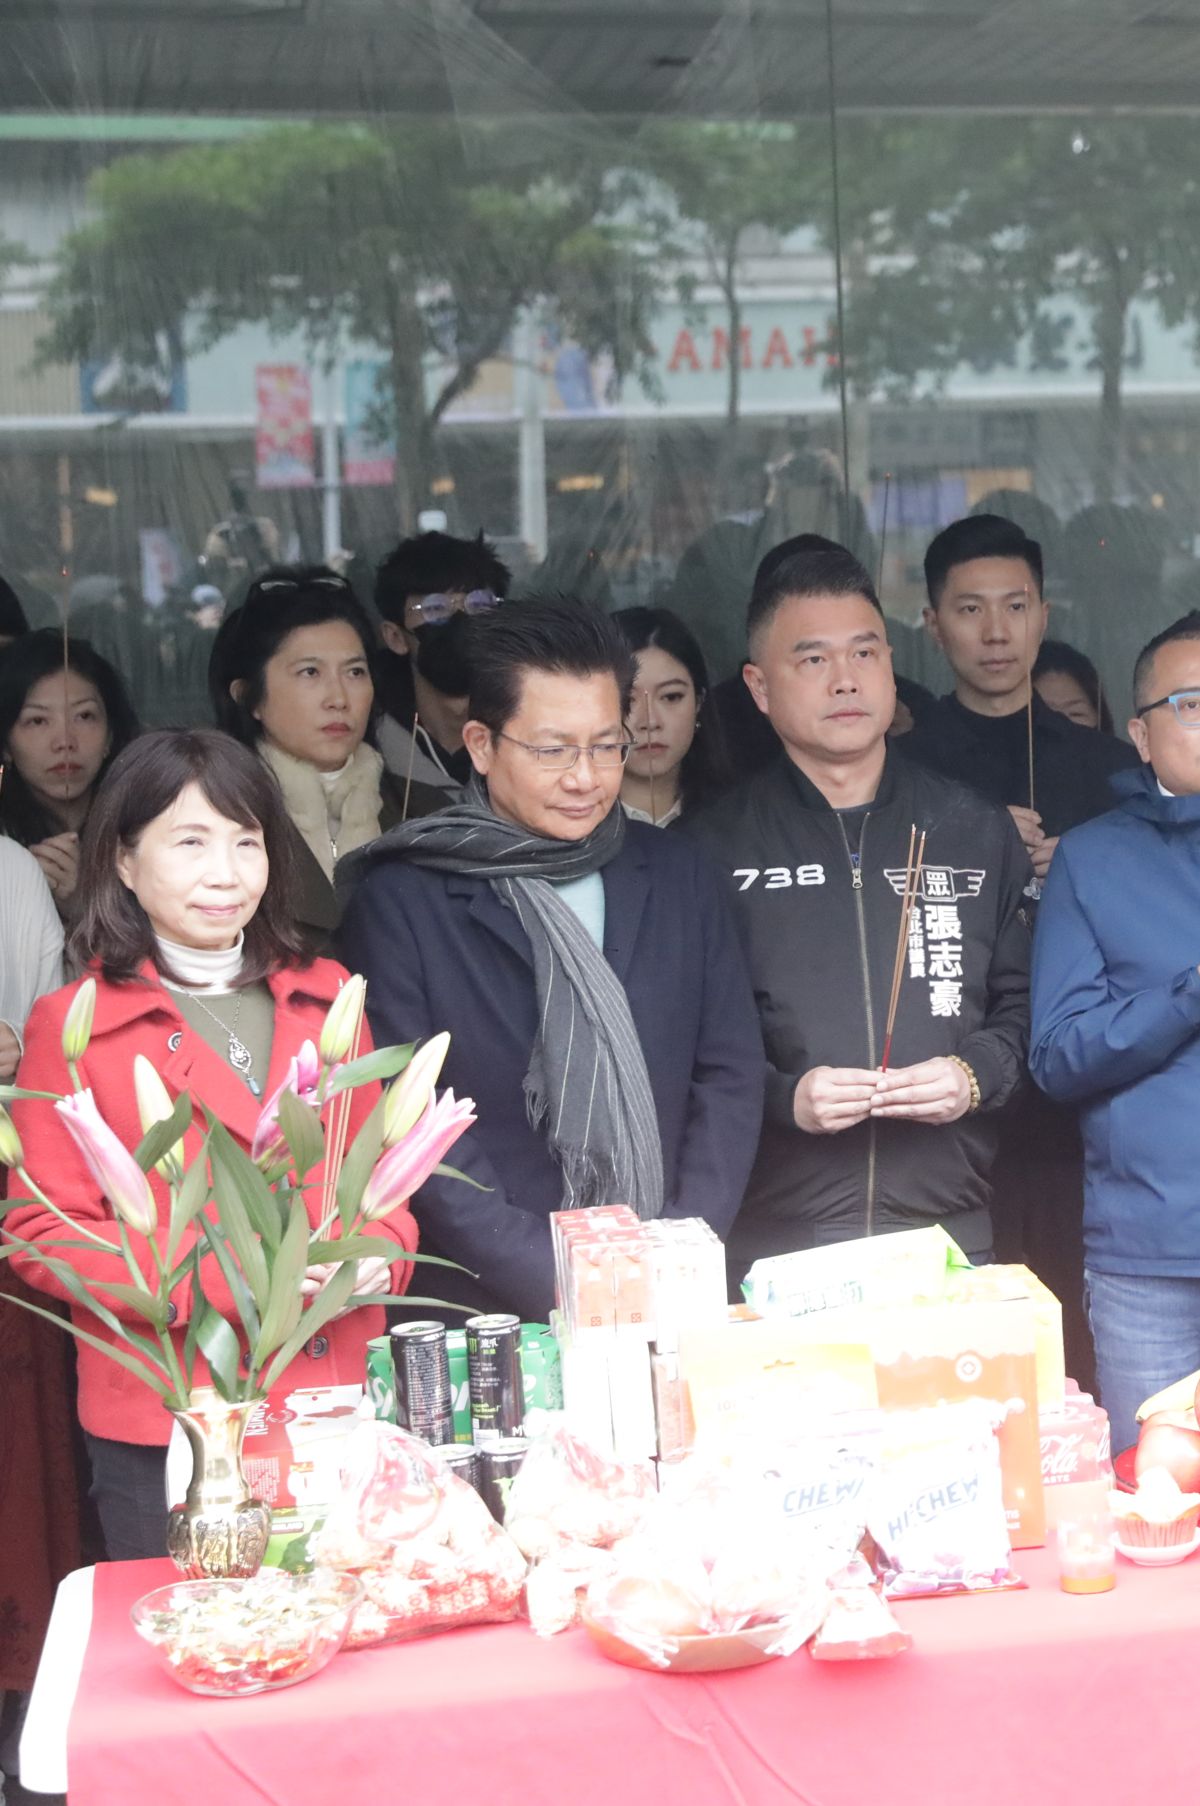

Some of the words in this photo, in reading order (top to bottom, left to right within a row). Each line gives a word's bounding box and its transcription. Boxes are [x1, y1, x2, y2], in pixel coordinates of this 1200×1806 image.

[733, 863, 826, 891] 738
[925, 904, 963, 1017] 張志豪
